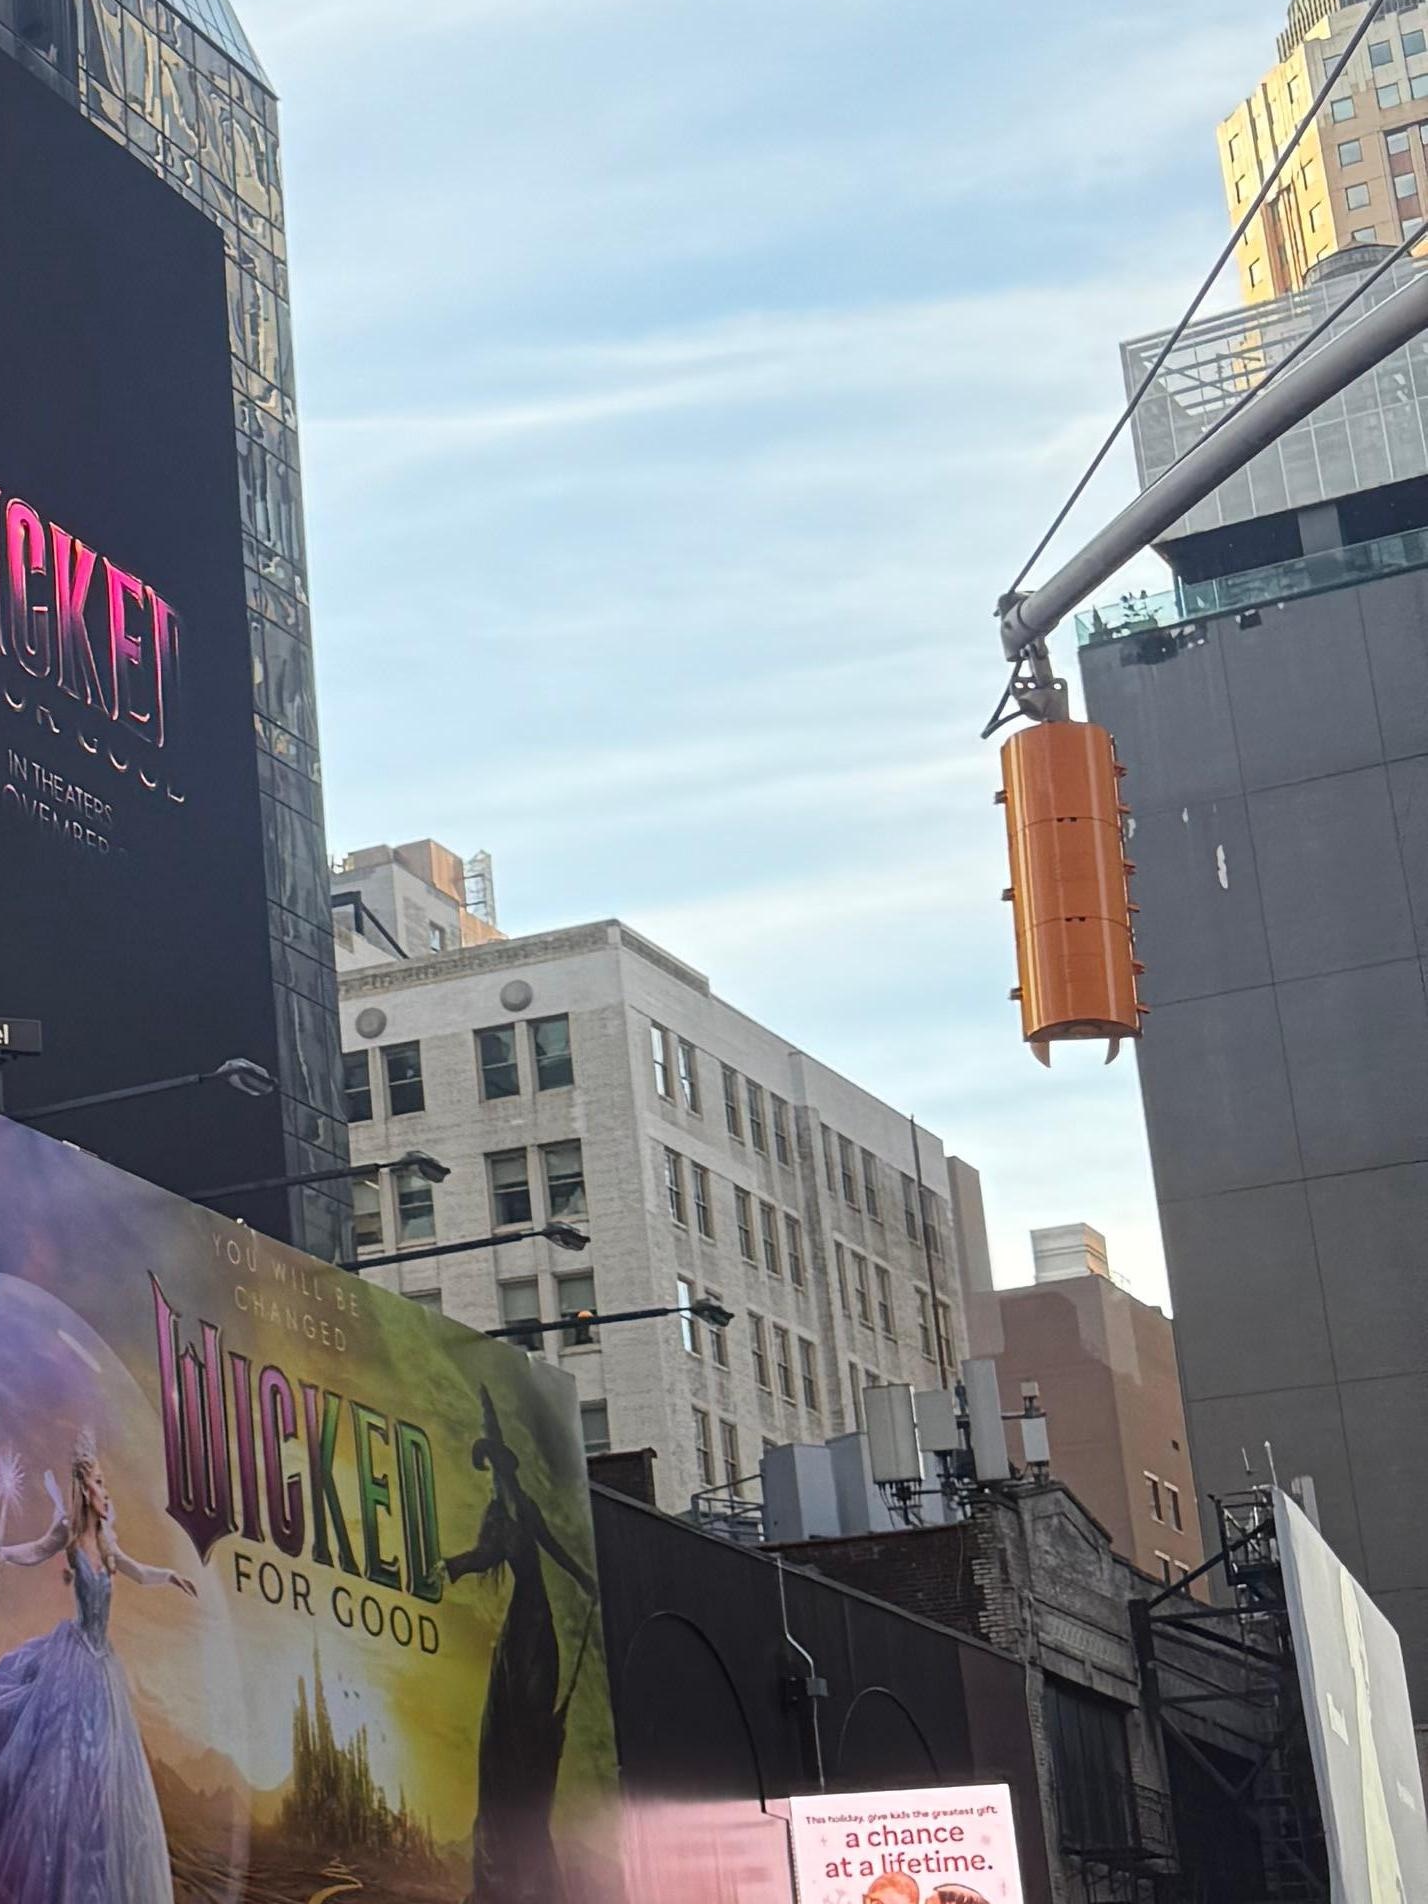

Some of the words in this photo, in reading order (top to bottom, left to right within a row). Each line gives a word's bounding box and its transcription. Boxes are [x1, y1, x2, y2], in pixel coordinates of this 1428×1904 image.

[8, 749, 28, 783] IN
[32, 763, 113, 825] THEATERS
[212, 1231, 257, 1272] YOU
[272, 1262, 323, 1301] WILL
[336, 1287, 360, 1318] BE
[234, 1286, 346, 1352] CHANGED
[147, 1269, 444, 1604] WICKED
[234, 1552, 315, 1616] FOR
[332, 1586, 440, 1655] GOOD
[846, 1832, 860, 1848] a
[868, 1824, 964, 1848] chance
[913, 1809, 929, 1818] the
[825, 1856, 852, 1879] at
[859, 1860, 874, 1876] a
[881, 1850, 994, 1875] lifetime.
